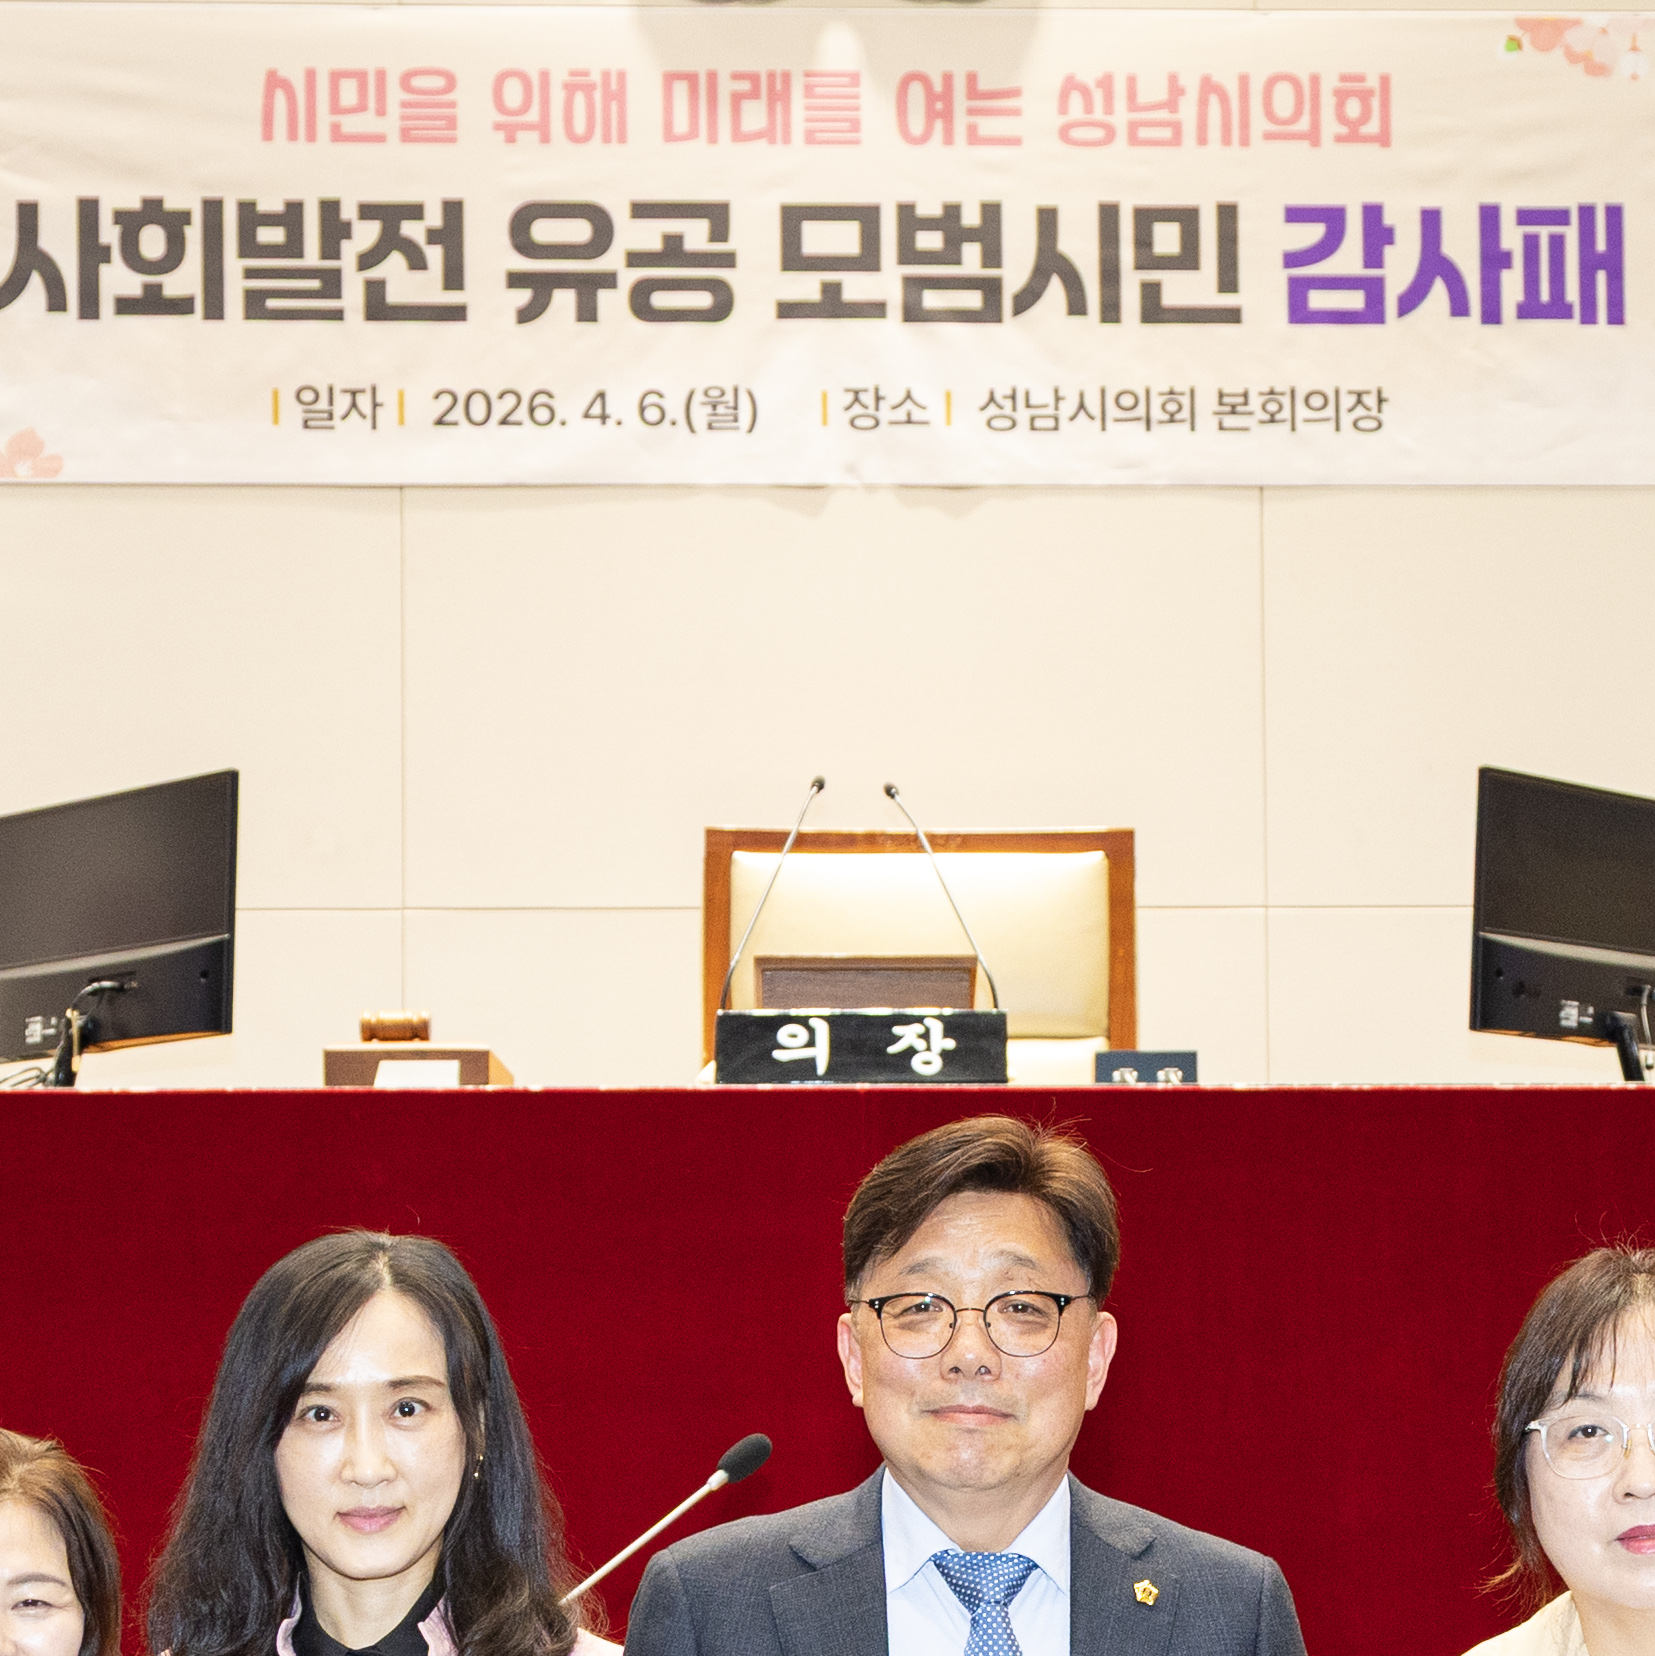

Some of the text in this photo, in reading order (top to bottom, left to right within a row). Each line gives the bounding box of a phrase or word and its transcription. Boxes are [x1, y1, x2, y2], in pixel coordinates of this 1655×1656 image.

[261, 66, 1394, 149] 시민을 위해 미래를 여는 성남시의회
[505, 196, 738, 326] 유공
[774, 200, 1243, 325] 모범시민
[1281, 200, 1626, 327] 감사패
[293, 383, 1389, 433] 일자 2026. 4. 6.(월) 장소 성남시의회 본회의장
